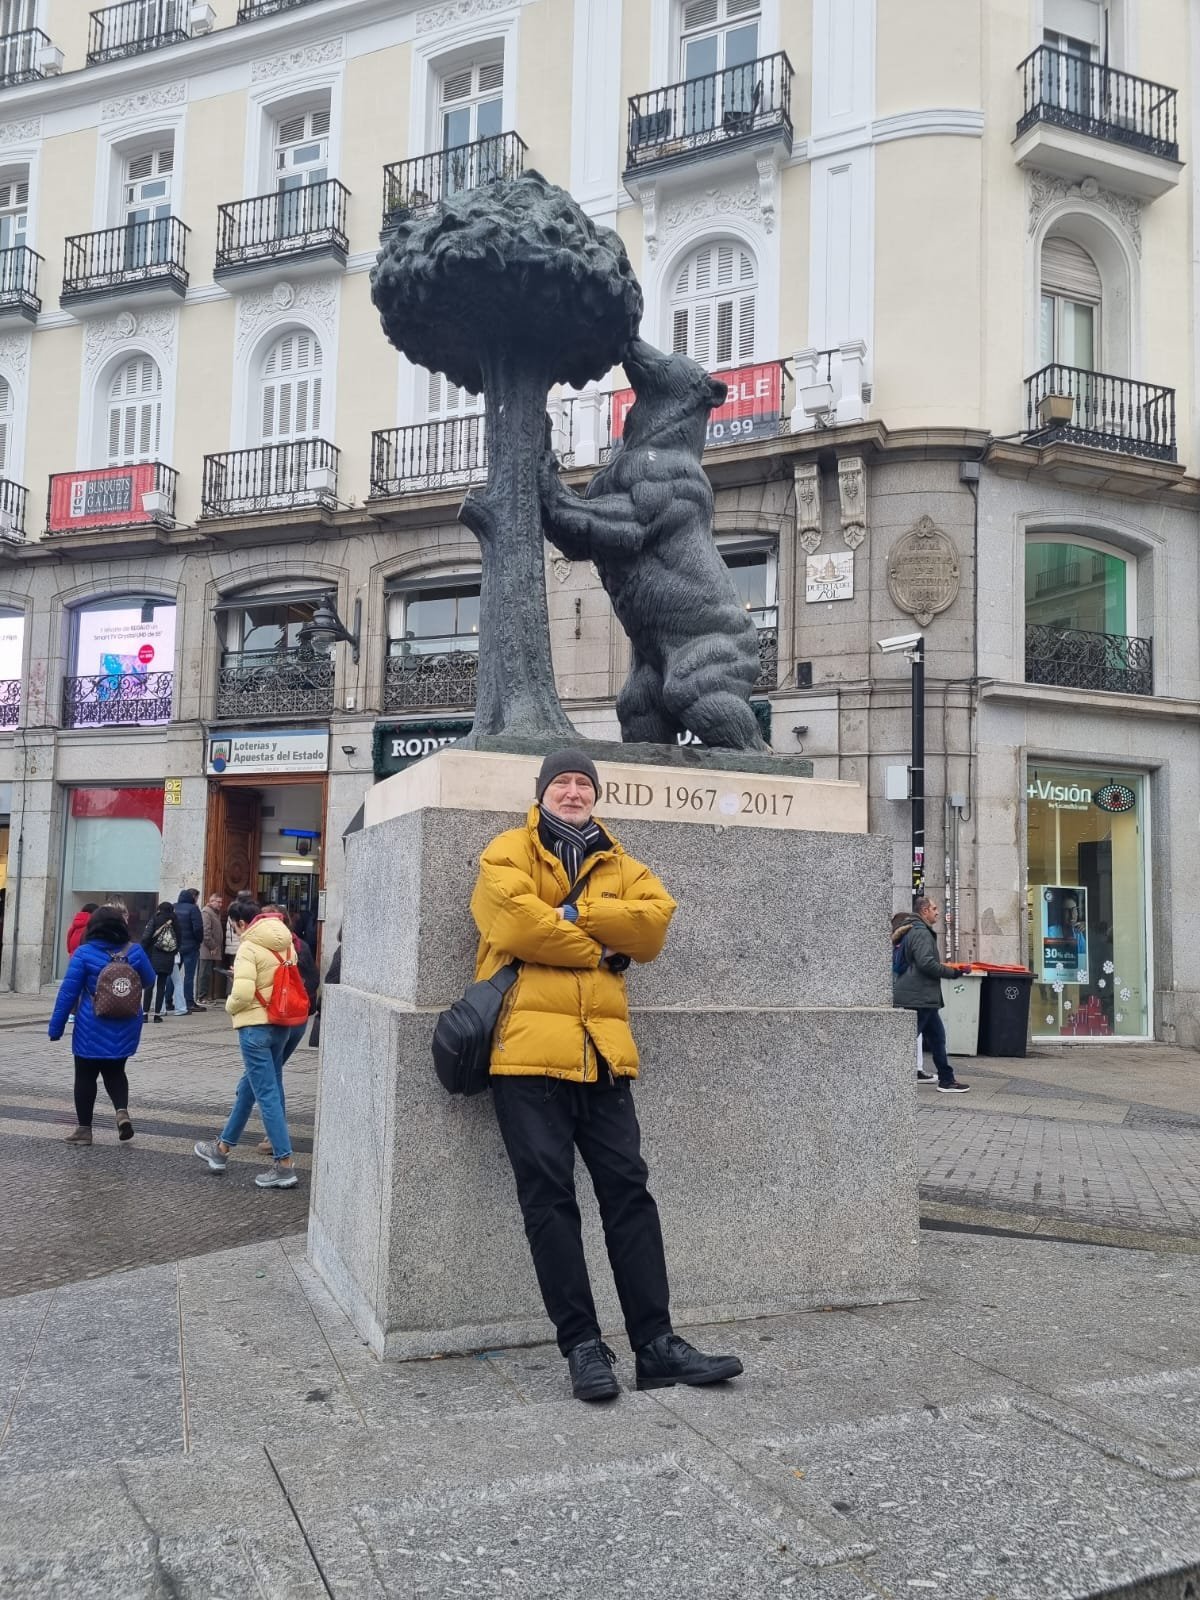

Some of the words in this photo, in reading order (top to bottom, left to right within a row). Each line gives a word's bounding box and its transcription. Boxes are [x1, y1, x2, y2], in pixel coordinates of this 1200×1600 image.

[730, 419, 753, 436] 99
[88, 478, 130, 494] BUSQUETS
[272, 742, 278, 752] y
[233, 753, 274, 764] Apuestas
[277, 751, 290, 761] del
[292, 749, 324, 760] Estado
[664, 786, 717, 812] 1967
[741, 791, 794, 816] 2017
